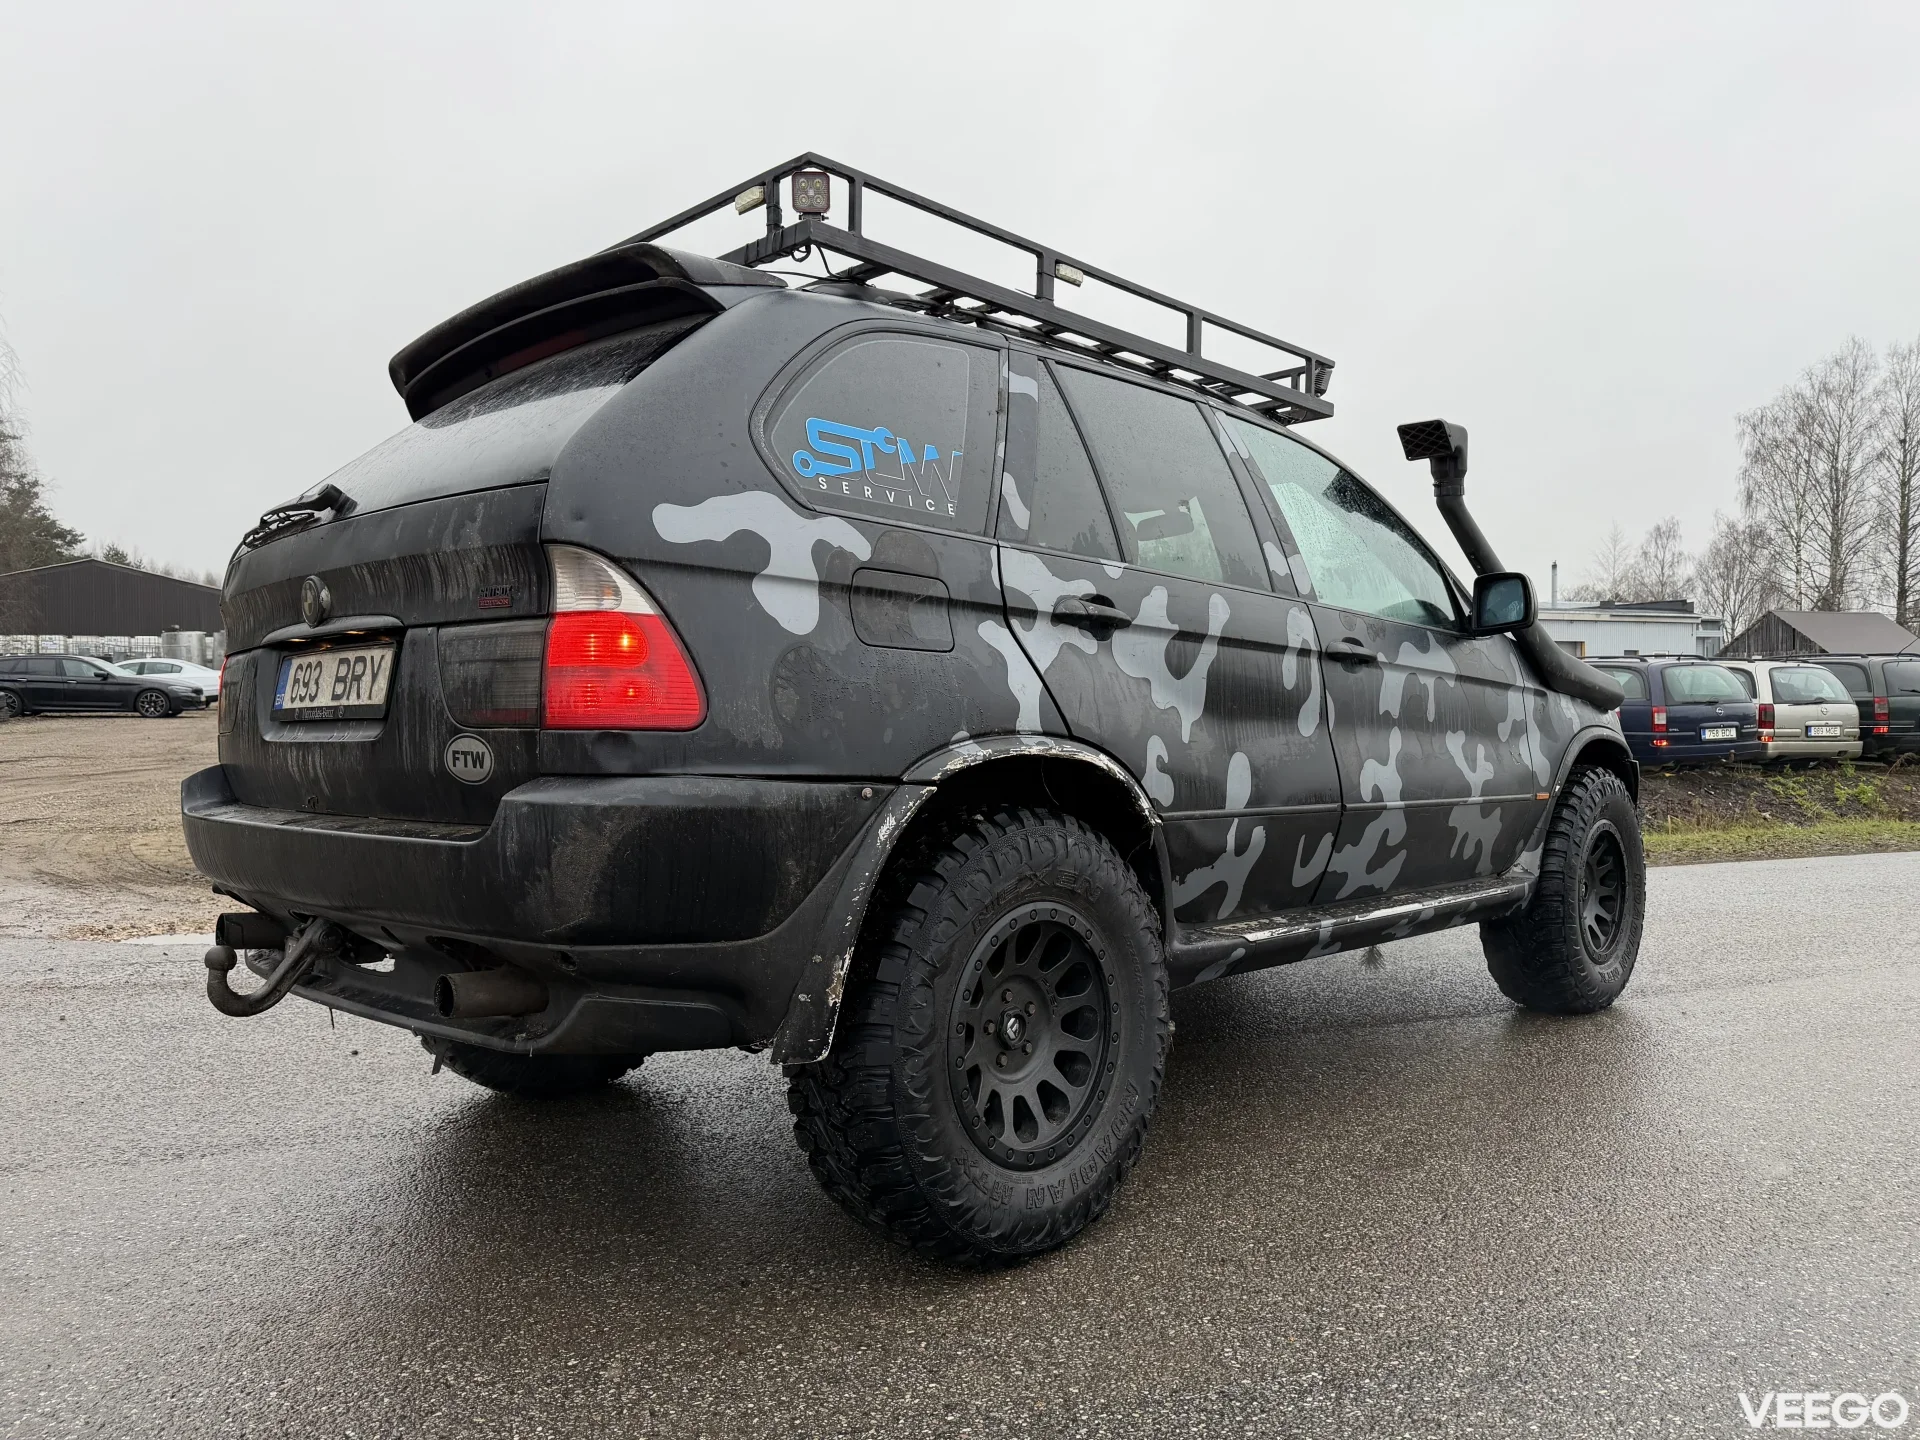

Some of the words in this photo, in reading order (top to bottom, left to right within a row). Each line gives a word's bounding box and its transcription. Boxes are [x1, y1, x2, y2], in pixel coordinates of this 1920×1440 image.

[818, 476, 955, 516] SERVICE
[290, 660, 323, 704] 693
[331, 654, 386, 701] BRY
[452, 749, 486, 770] FTW
[971, 868, 1104, 935] NEXEN
[1026, 1079, 1139, 1210] ROADIAN
[954, 1147, 1015, 1206] MTX
